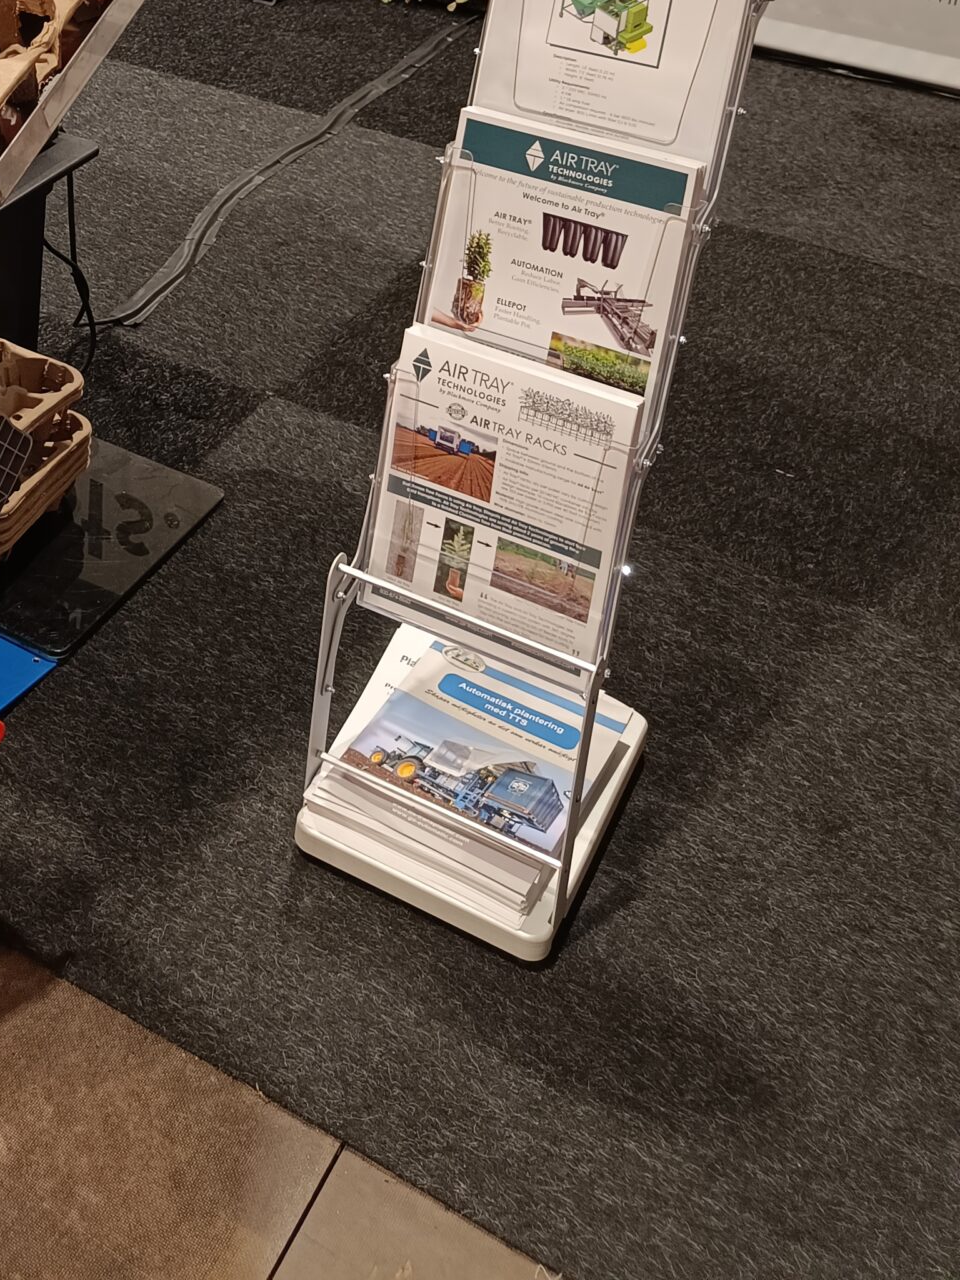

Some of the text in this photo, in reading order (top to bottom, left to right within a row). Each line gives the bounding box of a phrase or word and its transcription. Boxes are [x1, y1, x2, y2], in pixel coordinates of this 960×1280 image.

[548, 164, 613, 188] TECHNOLOGIES
[476, 170, 497, 182] lcome
[498, 175, 506, 184] to
[506, 176, 517, 186] the
[515, 178, 539, 194] future
[539, 185, 547, 195] of
[548, 186, 585, 203] sustainable
[585, 197, 622, 214] production
[522, 192, 560, 209] Welcome
[561, 201, 570, 211] to
[571, 203, 583, 214] Air
[494, 210, 507, 220] AIR
[510, 258, 564, 279] AUTOMATION
[496, 297, 527, 312] ELLEPOT
[437, 377, 507, 407] TECHNOLOGIES
[439, 388, 446, 396] by
[475, 400, 502, 414] Company
[470, 415, 491, 430] AIR
[525, 433, 568, 456] RACKS
[458, 681, 565, 735] Automatisk plantering
[483, 702, 529, 727] med TTS
